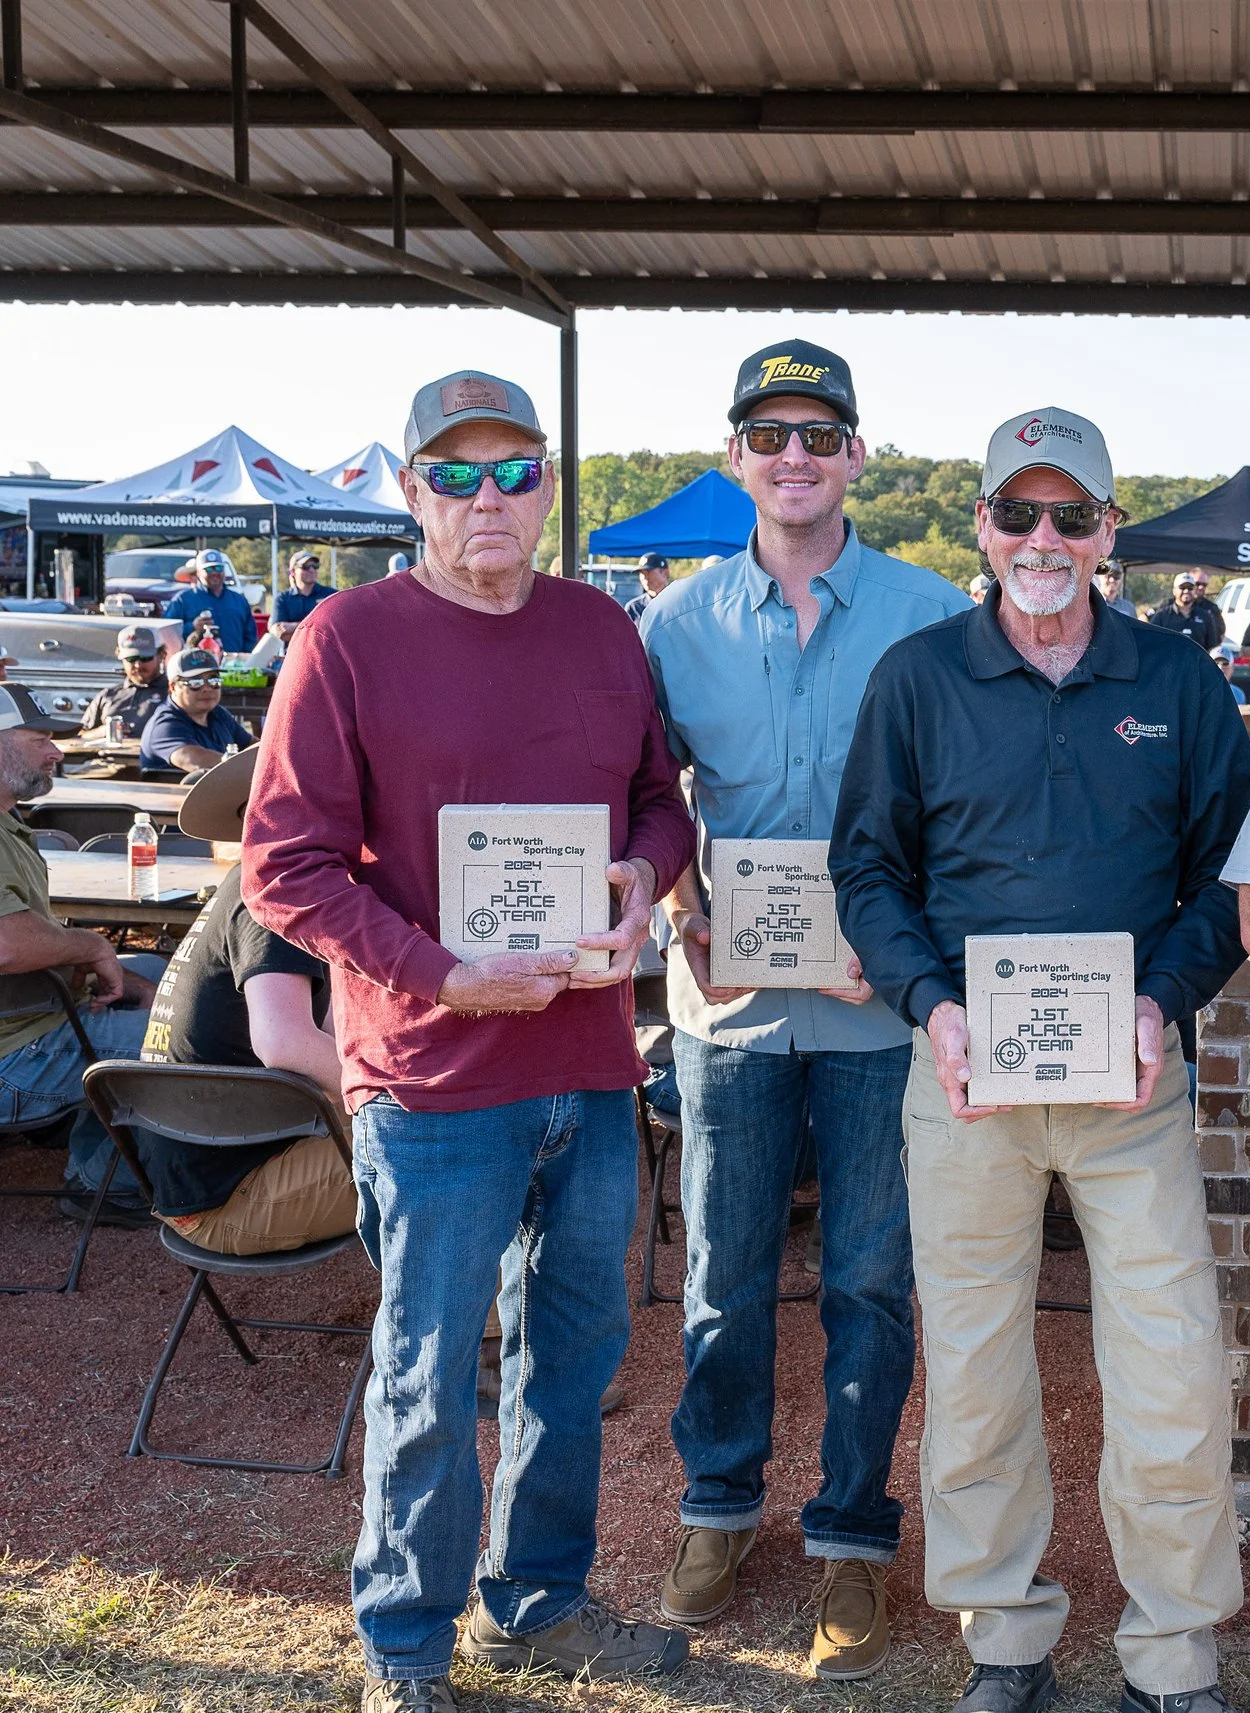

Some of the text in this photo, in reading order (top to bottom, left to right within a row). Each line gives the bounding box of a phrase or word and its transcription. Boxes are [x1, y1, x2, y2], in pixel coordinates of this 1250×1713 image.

[455, 398, 496, 410] NATIONALS
[1030, 424, 1082, 439] ELEMENTS
[57, 511, 247, 529] www.vadensacoustics.com
[293, 517, 405, 535] www.vadensacoustics.com
[492, 837, 543, 845] Fort Worth
[523, 846, 585, 856] Sporting Clay
[504, 861, 542, 870] 2024
[758, 864, 774, 872] Fort
[785, 873, 819, 882] Sporting
[504, 881, 542, 892] 1ST
[768, 886, 800, 895] 2024
[491, 895, 555, 908] PLACE
[767, 904, 800, 915] 1ST
[500, 910, 546, 921] TEAM
[756, 917, 812, 929] PLACE
[763, 931, 804, 942] TEAM
[1019, 964, 1069, 972] Fort Worth
[1050, 973, 1111, 982] Sporting Clay
[1031, 988, 1068, 998] 2024
[1031, 1009, 1069, 1021] 1ST
[1018, 1024, 1081, 1037] PLACE
[1027, 1040, 1073, 1051] TEAM
